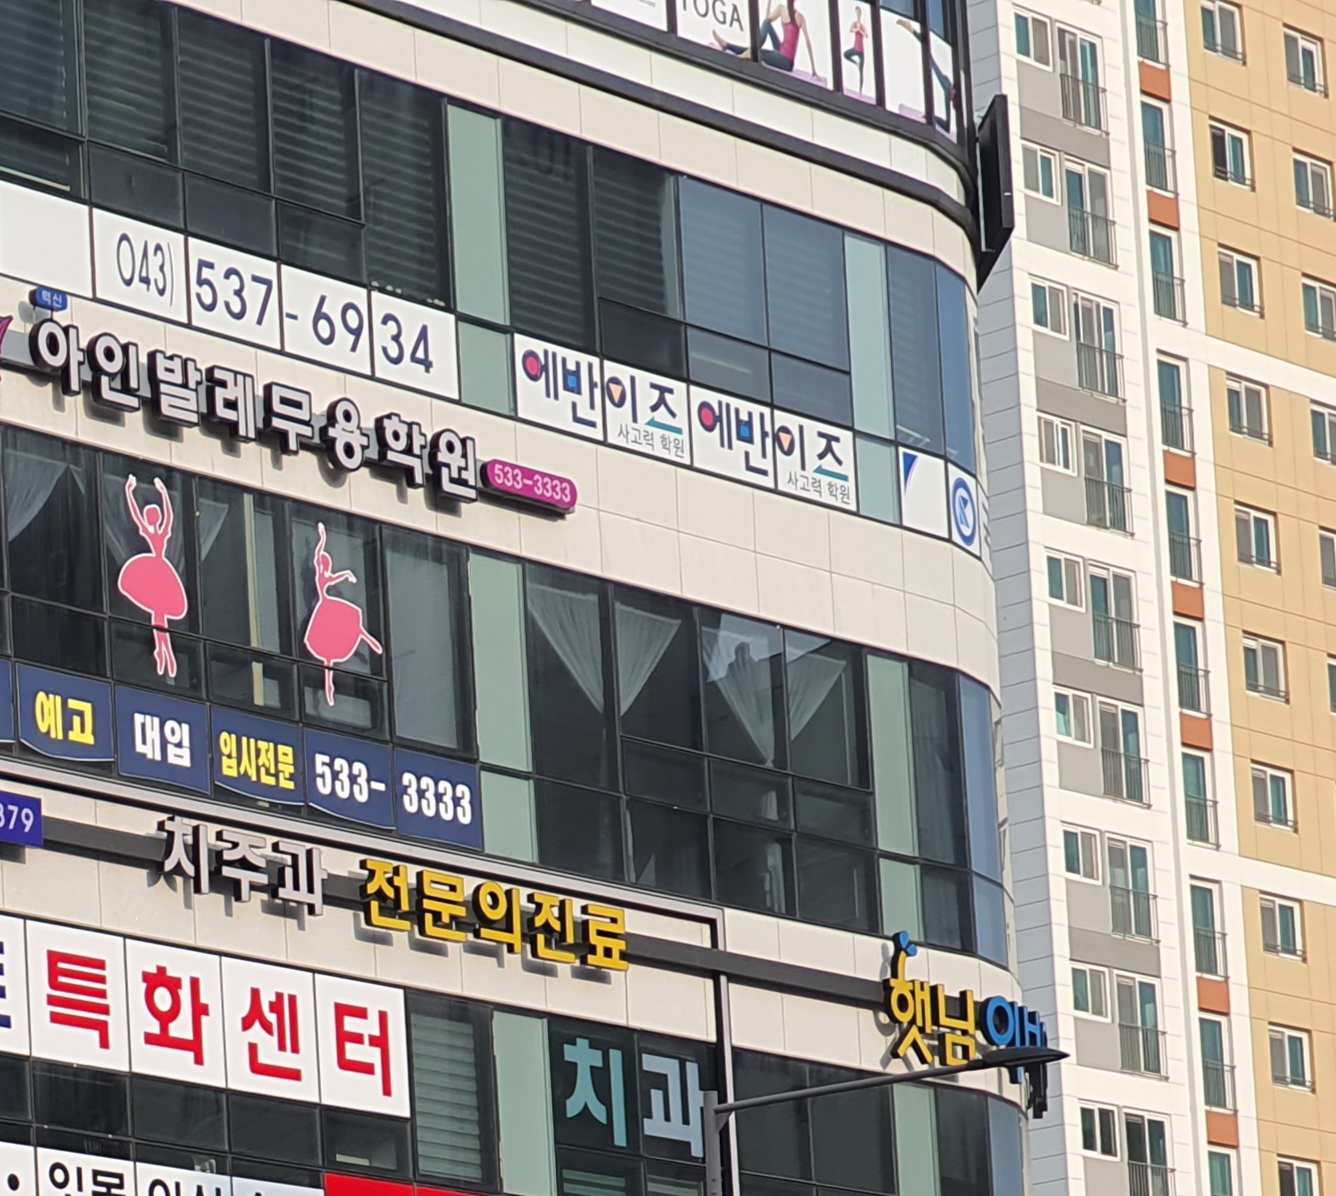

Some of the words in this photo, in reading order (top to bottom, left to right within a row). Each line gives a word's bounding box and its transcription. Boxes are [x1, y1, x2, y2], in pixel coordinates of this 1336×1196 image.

[493, 461, 572, 503] 533-3333
[35, 690, 97, 746] 예고
[134, 712, 192, 767] 대입
[219, 731, 296, 791] 입시전문
[159, 815, 328, 916] 치주과
[359, 856, 630, 971] 전문의진료
[564, 1036, 708, 1158] 치과
